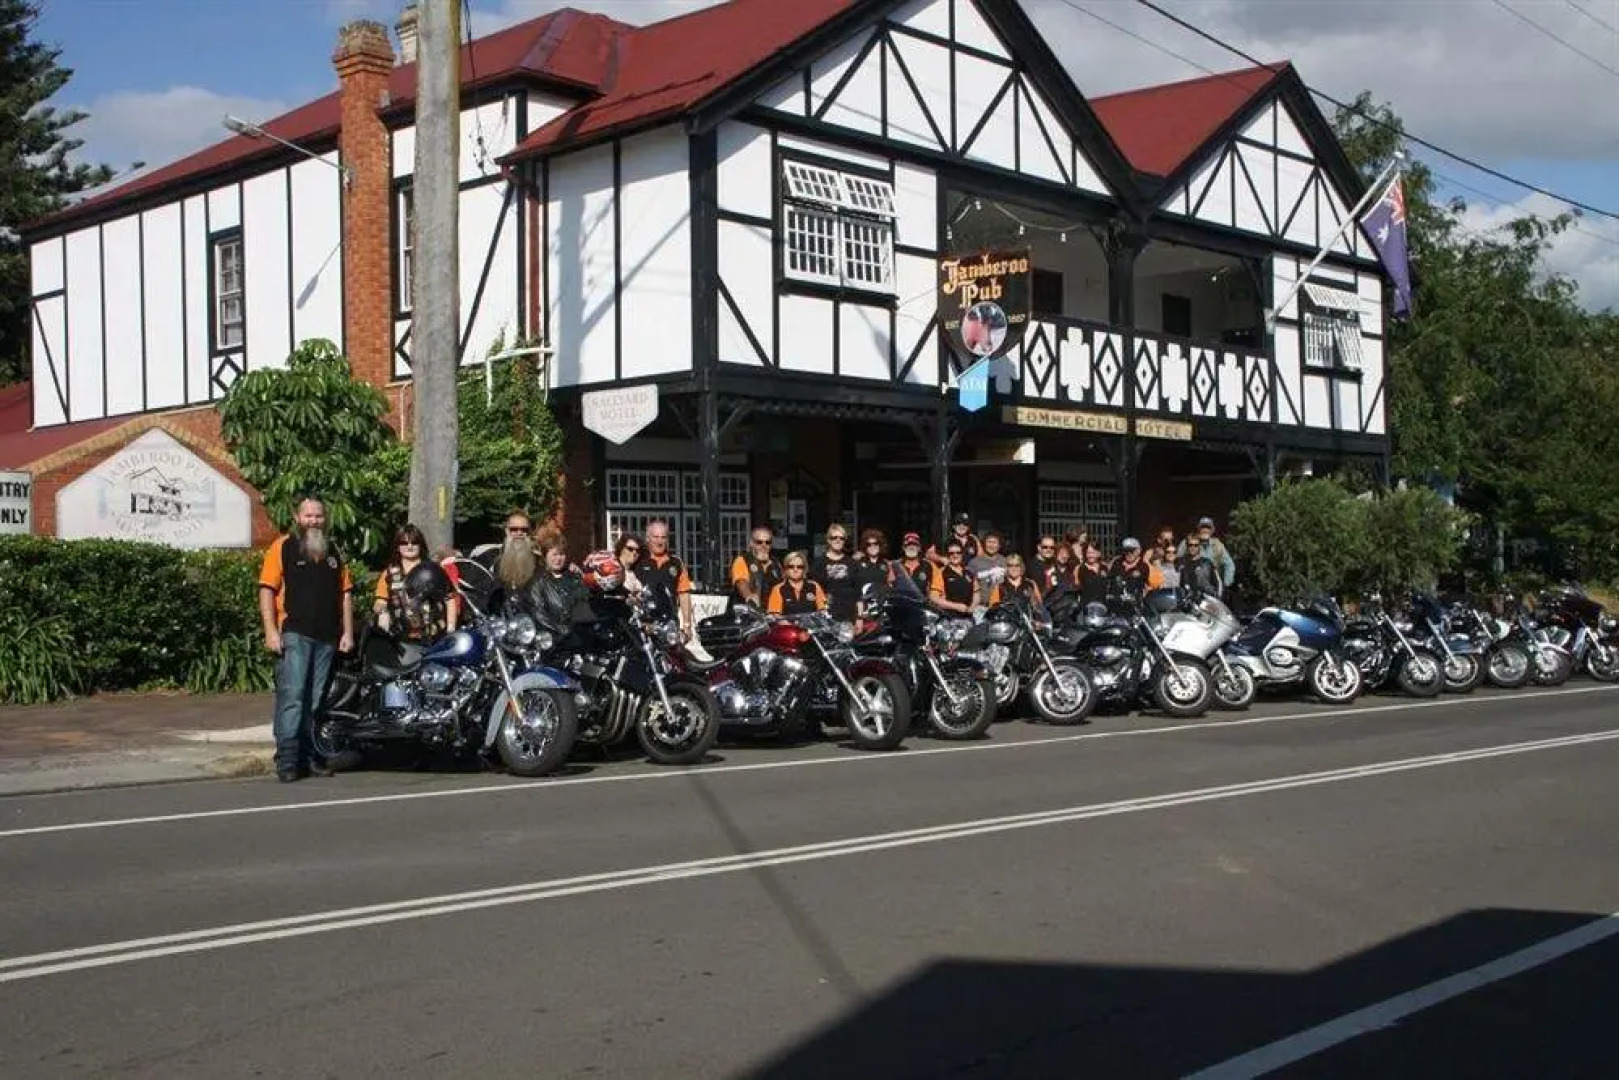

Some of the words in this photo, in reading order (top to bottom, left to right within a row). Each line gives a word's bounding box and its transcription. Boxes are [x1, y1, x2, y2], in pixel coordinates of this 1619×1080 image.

[941, 254, 1029, 294] Jamberoo
[958, 277, 1003, 308] Pub
[1011, 409, 1123, 432] COMMERCIAL
[1, 508, 27, 524] NLY
